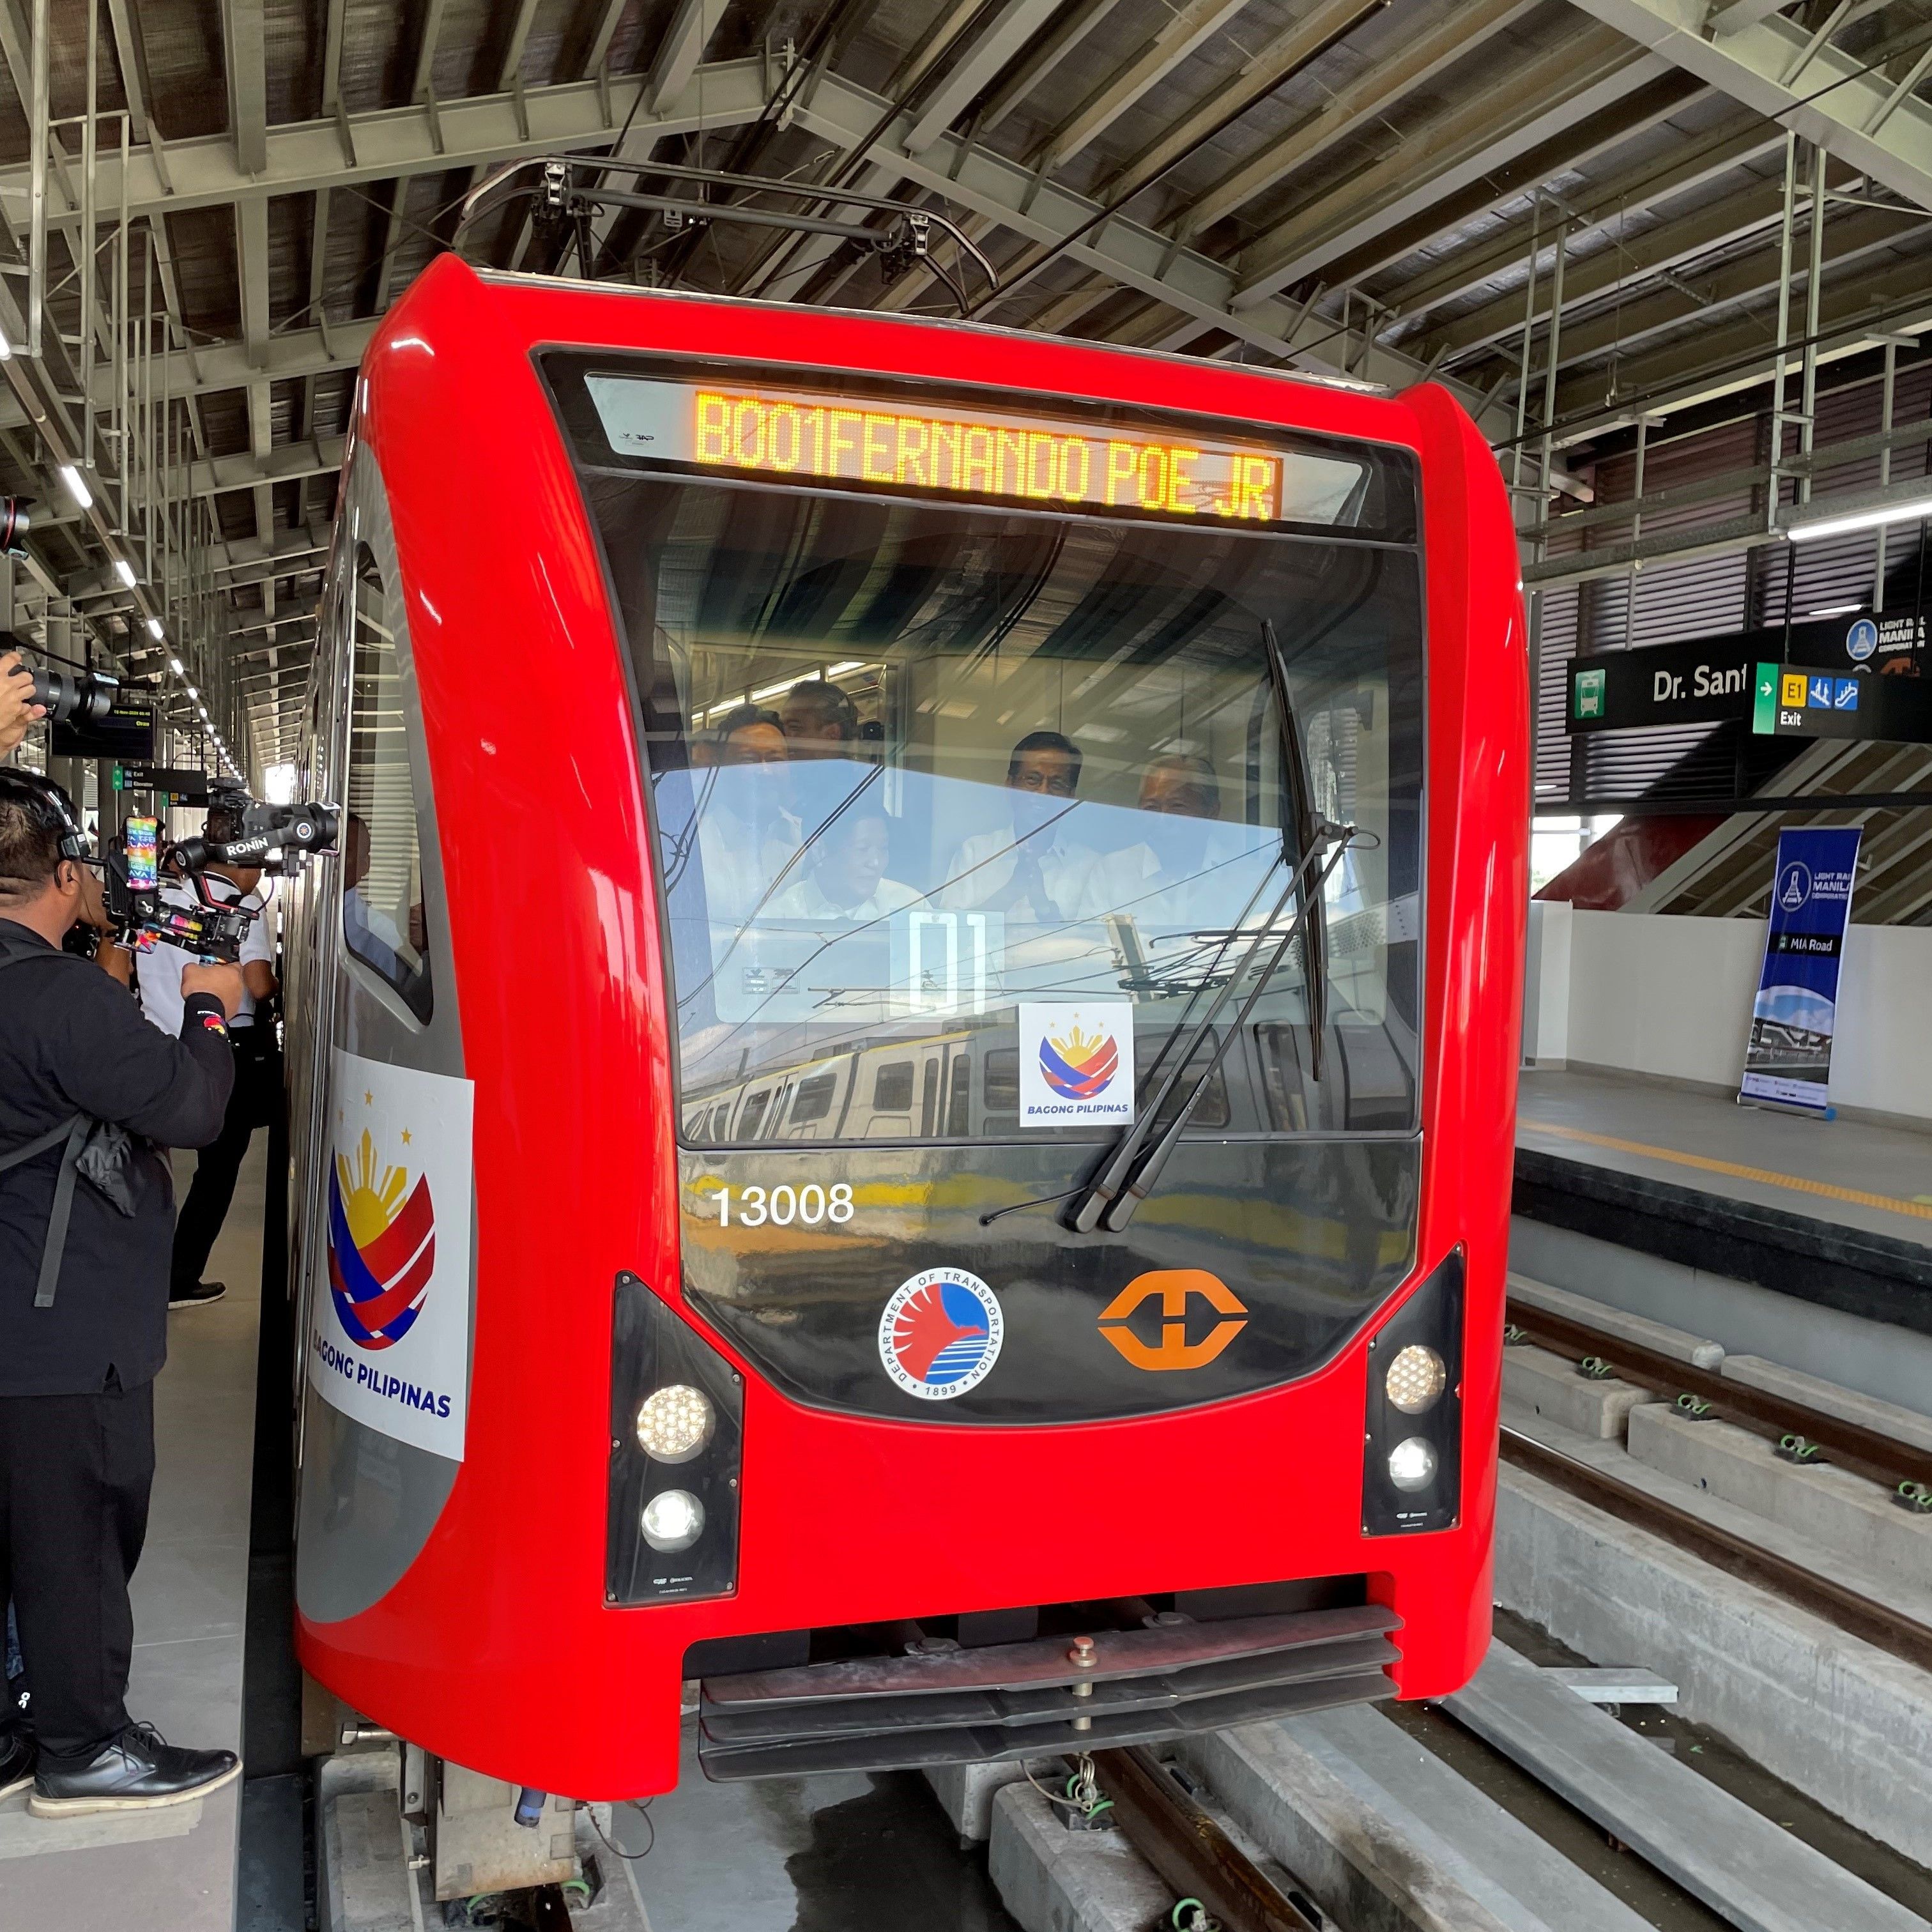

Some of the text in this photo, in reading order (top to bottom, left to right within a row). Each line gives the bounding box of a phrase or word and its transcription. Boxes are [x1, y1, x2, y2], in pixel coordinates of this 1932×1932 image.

[1105, 439, 1199, 514] POE
[1215, 453, 1271, 522] JR
[1653, 670, 1686, 702] Dr.
[1788, 682, 1802, 700] E1
[1780, 710, 1802, 726] Exit
[226, 837, 269, 856] RONIN
[1790, 937, 1833, 952] MIA Road
[909, 912, 986, 1015] 01
[1027, 1104, 1128, 1114] BAGONG PILIPINAS
[712, 1183, 854, 1227] 13008
[884, 1272, 999, 1382] DEPARTMENT OF TRANSPORTATION
[356, 1363, 451, 1418] PILIPINAS
[925, 1384, 956, 1396] 1899
